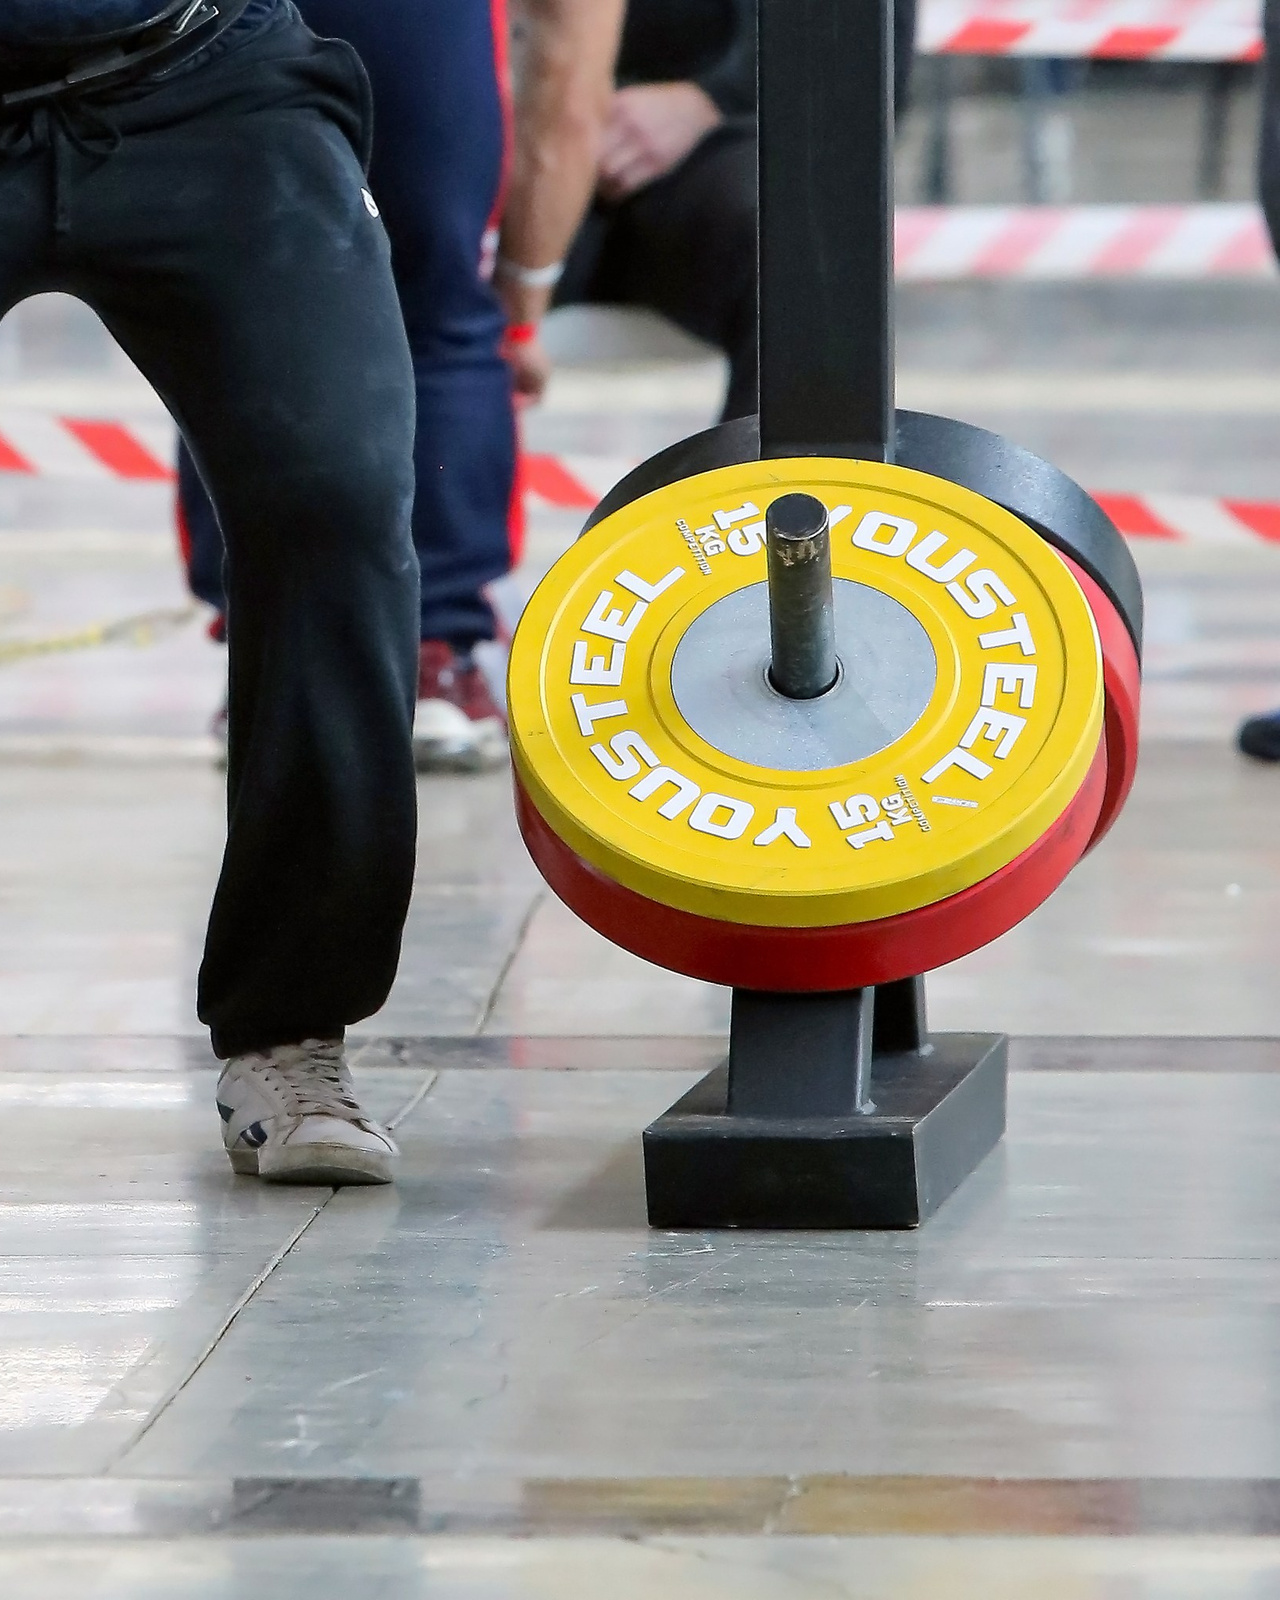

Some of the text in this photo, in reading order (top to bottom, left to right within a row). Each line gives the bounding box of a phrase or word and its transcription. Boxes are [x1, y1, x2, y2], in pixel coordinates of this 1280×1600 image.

[694, 524, 726, 557] KG
[713, 501, 767, 557] 15
[570, 565, 812, 849] YOUSTEEL
[828, 793, 895, 850] 15
[880, 792, 913, 826] KG
